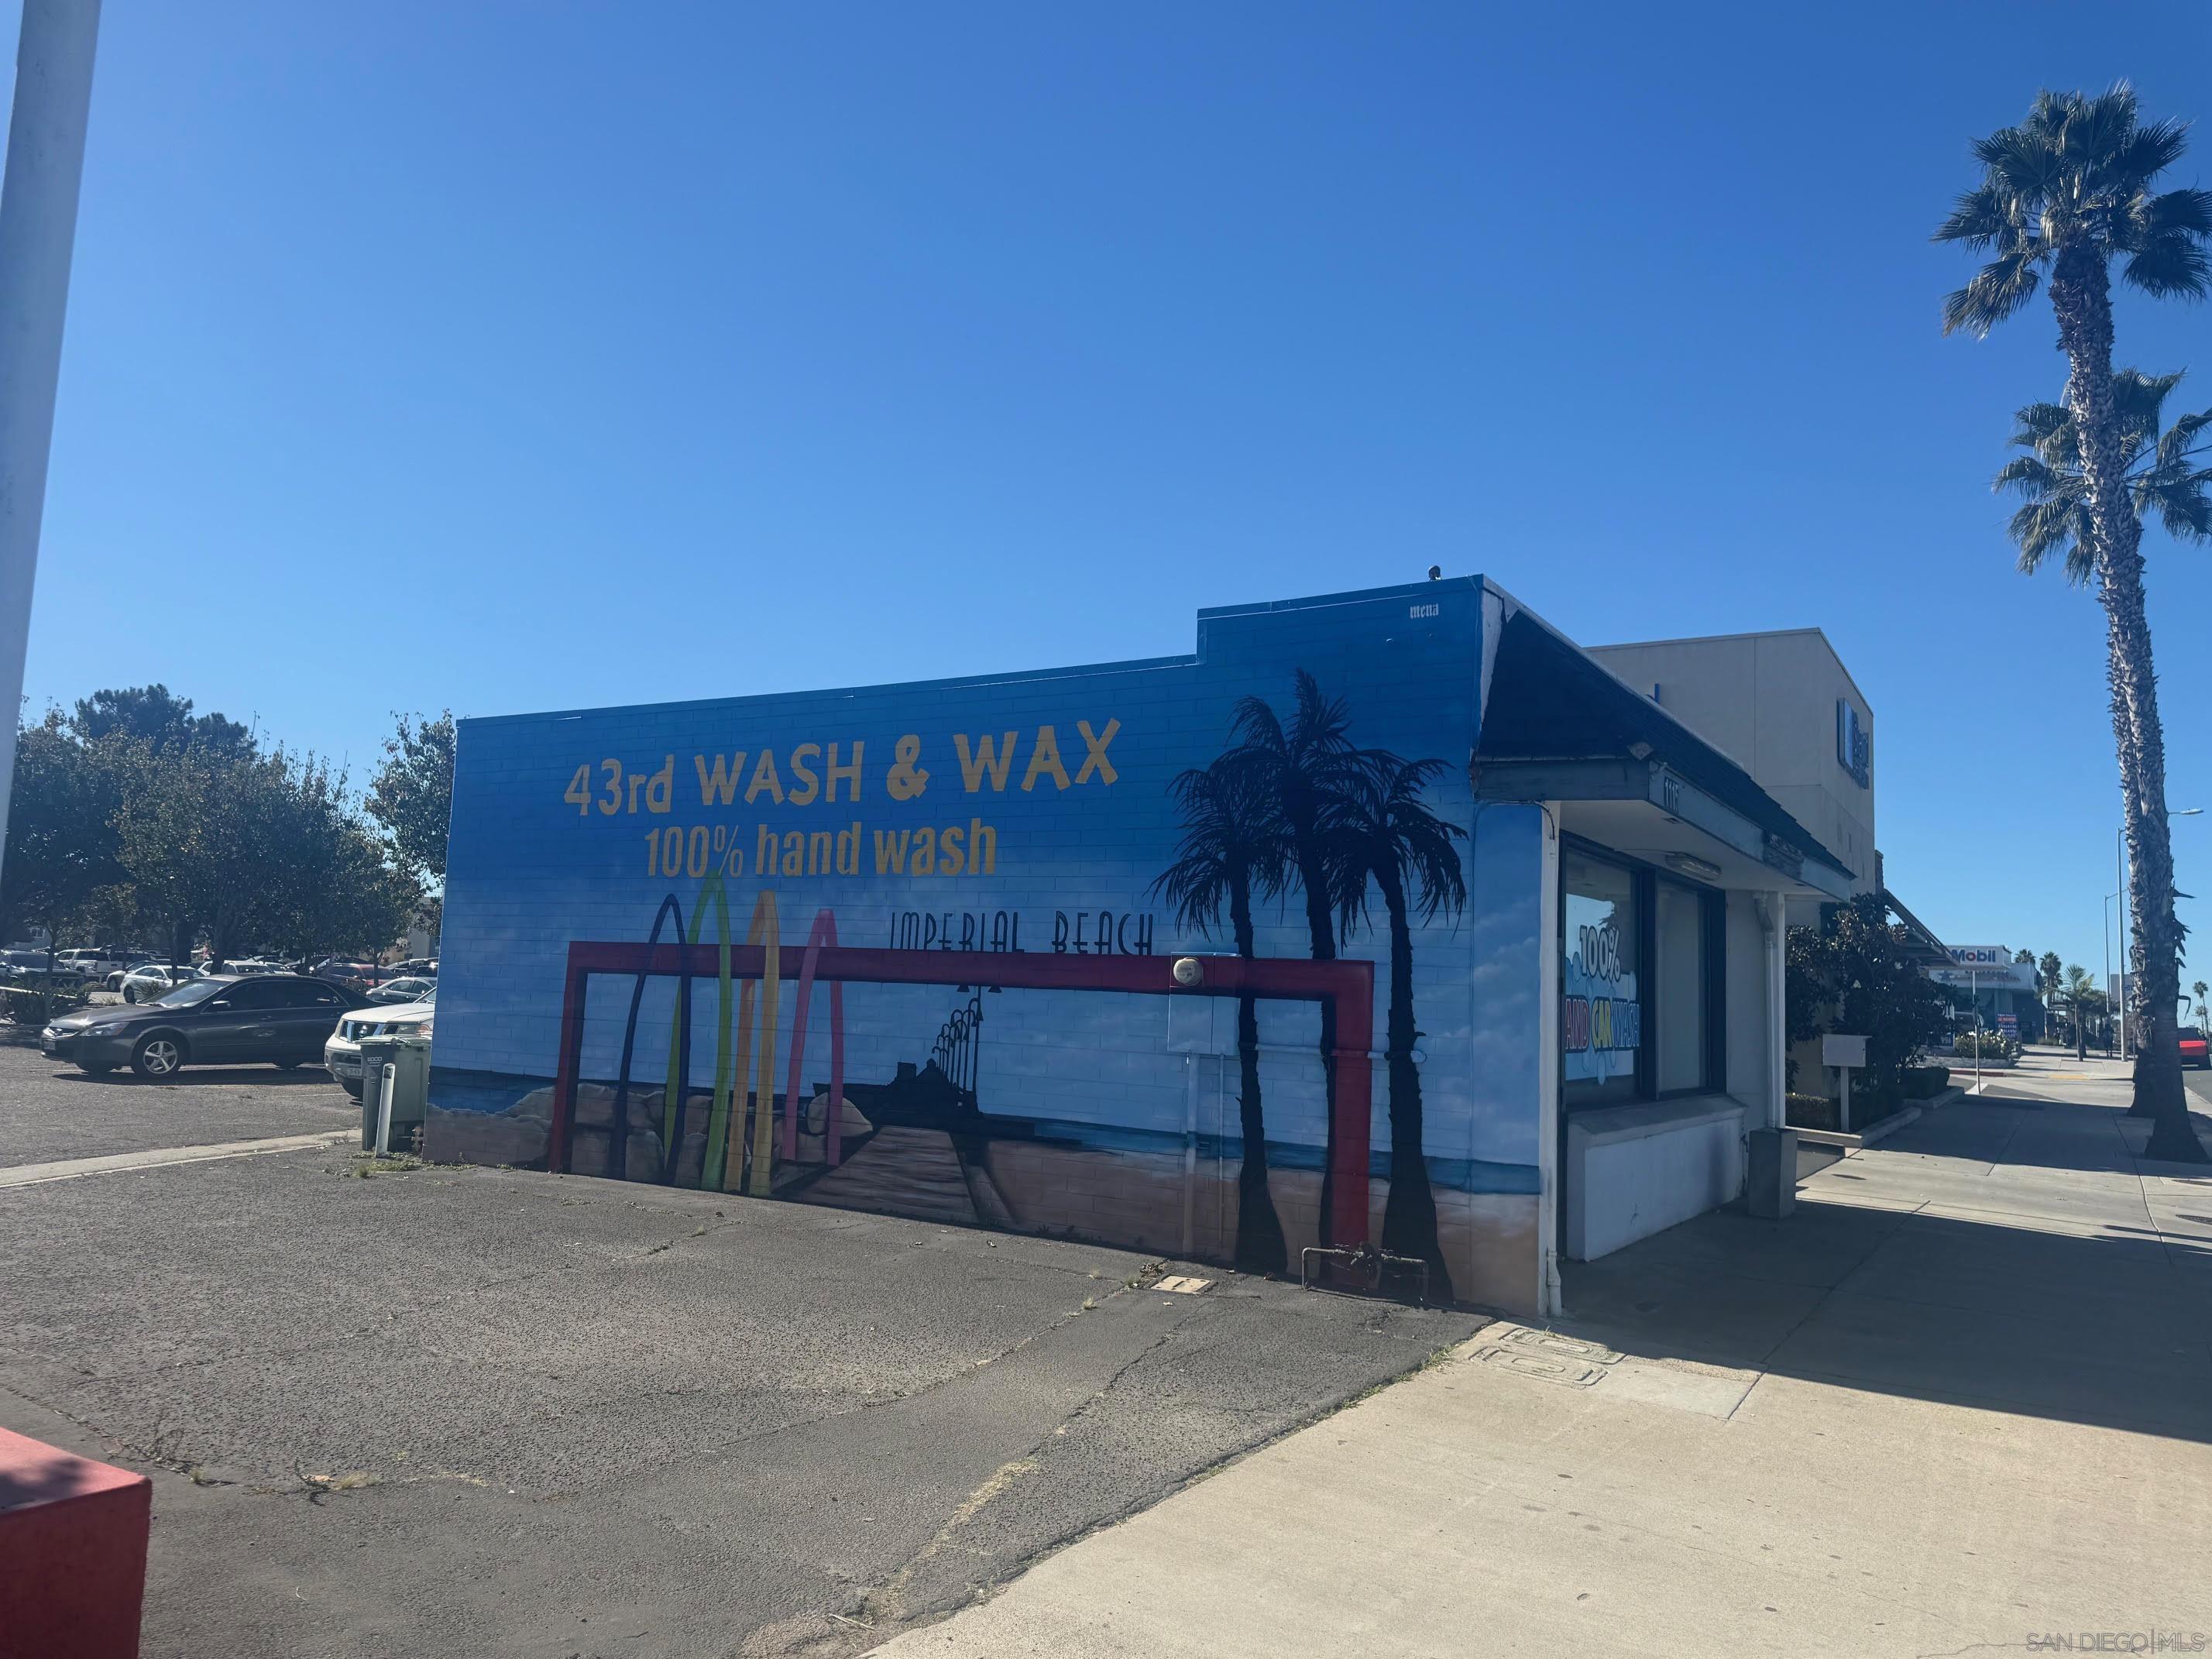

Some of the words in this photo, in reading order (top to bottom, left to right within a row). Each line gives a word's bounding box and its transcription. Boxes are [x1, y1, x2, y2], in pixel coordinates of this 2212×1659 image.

[564, 754, 675, 816] 43rd
[693, 741, 865, 805] WASH
[886, 734, 930, 801] &
[953, 717, 1121, 793] WAX
[644, 823, 744, 878] 100%
[755, 822, 861, 875] hand
[874, 818, 997, 875] wash
[890, 910, 1025, 953] IMPERIAL
[1052, 910, 1153, 956] BEACH
[1579, 926, 1620, 984] 100%
[1952, 949, 1996, 963] Mobil
[1592, 998, 1613, 1050] CAR
[1613, 1000, 1640, 1049] WASH
